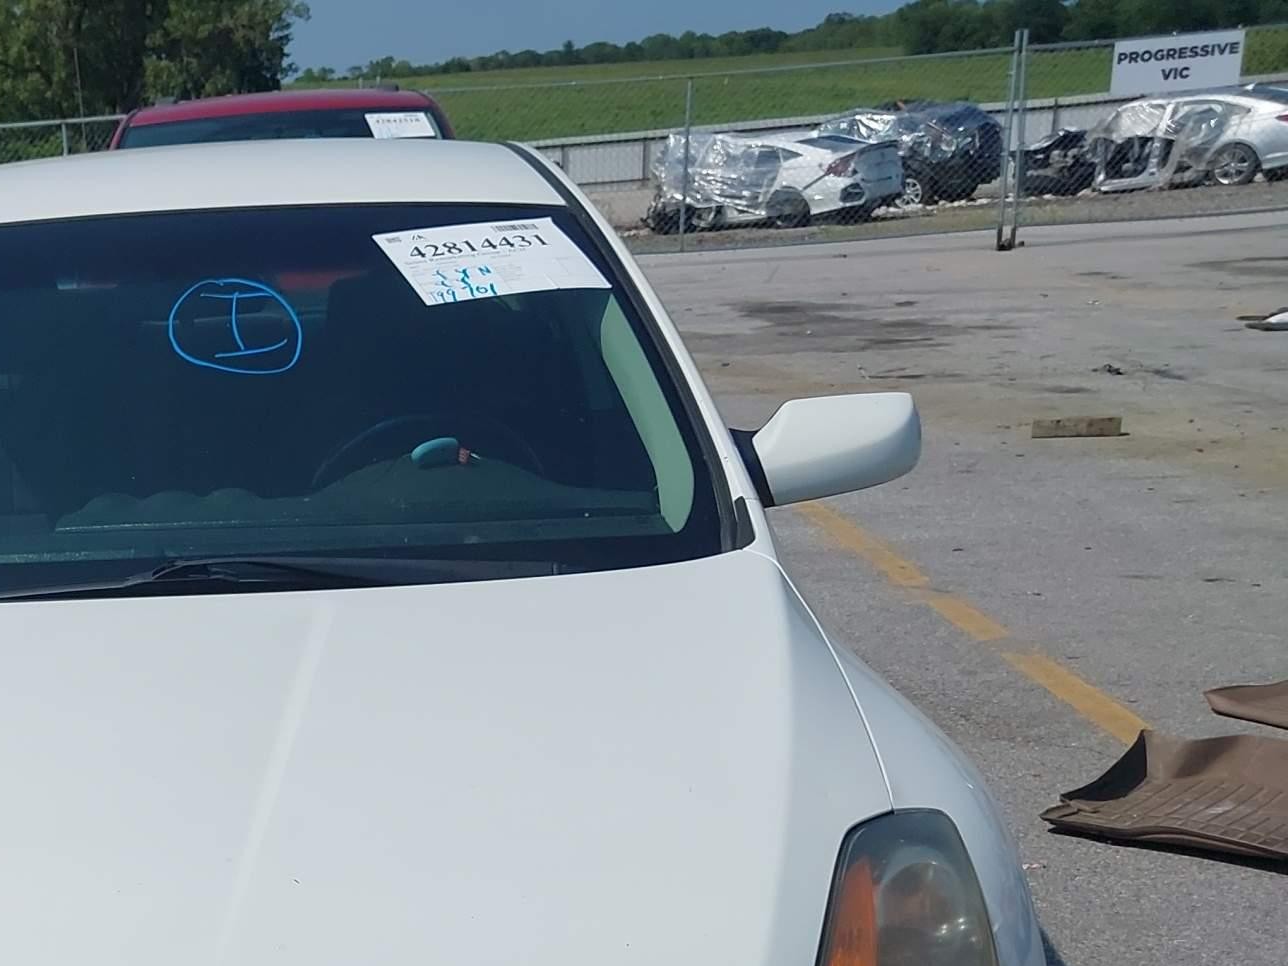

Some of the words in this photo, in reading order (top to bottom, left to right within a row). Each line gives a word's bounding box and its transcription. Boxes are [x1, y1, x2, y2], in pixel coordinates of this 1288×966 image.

[1116, 41, 1241, 65] PROGRESSIVE
[1160, 66, 1191, 81] VIC
[409, 233, 551, 260] 42814431
